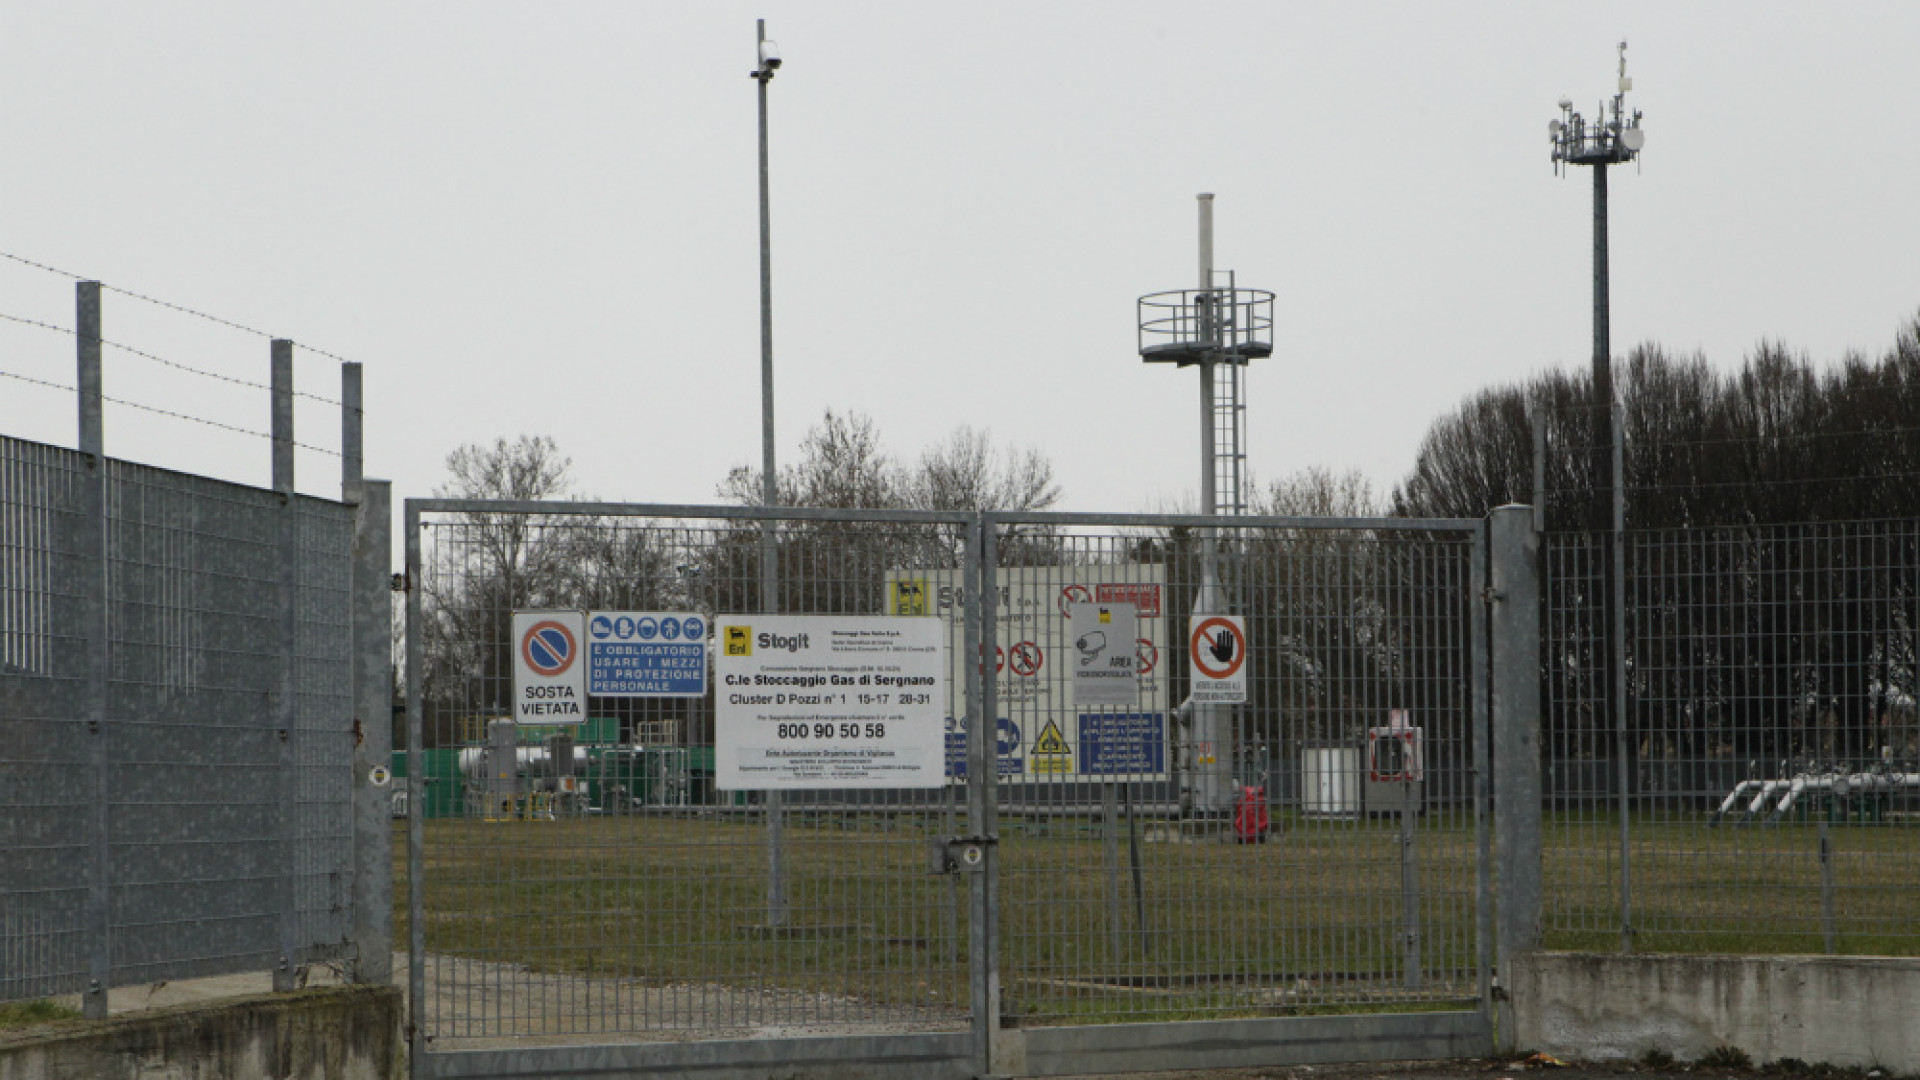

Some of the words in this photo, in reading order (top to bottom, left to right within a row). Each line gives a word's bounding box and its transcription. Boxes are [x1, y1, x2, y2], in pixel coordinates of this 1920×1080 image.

[758, 632, 809, 653] Stogit
[606, 645, 701, 656] OBBLIGATORIO
[594, 657, 640, 667] USARE
[648, 657, 652, 667] I
[661, 657, 701, 668] MEZZI
[594, 669, 608, 680] DI
[615, 669, 701, 680] PROTEZIONE
[754, 674, 826, 687] Stoccaggio
[831, 674, 855, 685] Gas
[858, 674, 871, 685] di
[874, 674, 936, 687] Sergnano
[525, 686, 575, 699] SOSTA
[594, 681, 671, 692] PERSONALE
[729, 693, 773, 705] Cluster
[776, 693, 786, 705] D
[788, 693, 821, 705] Pozzi
[840, 693, 846, 705] 1
[857, 693, 890, 705] 15-17
[521, 701, 581, 715] VIETATA
[778, 722, 809, 739] 800
[814, 722, 834, 739] 90
[840, 722, 859, 739] 50
[865, 722, 885, 739] 58
